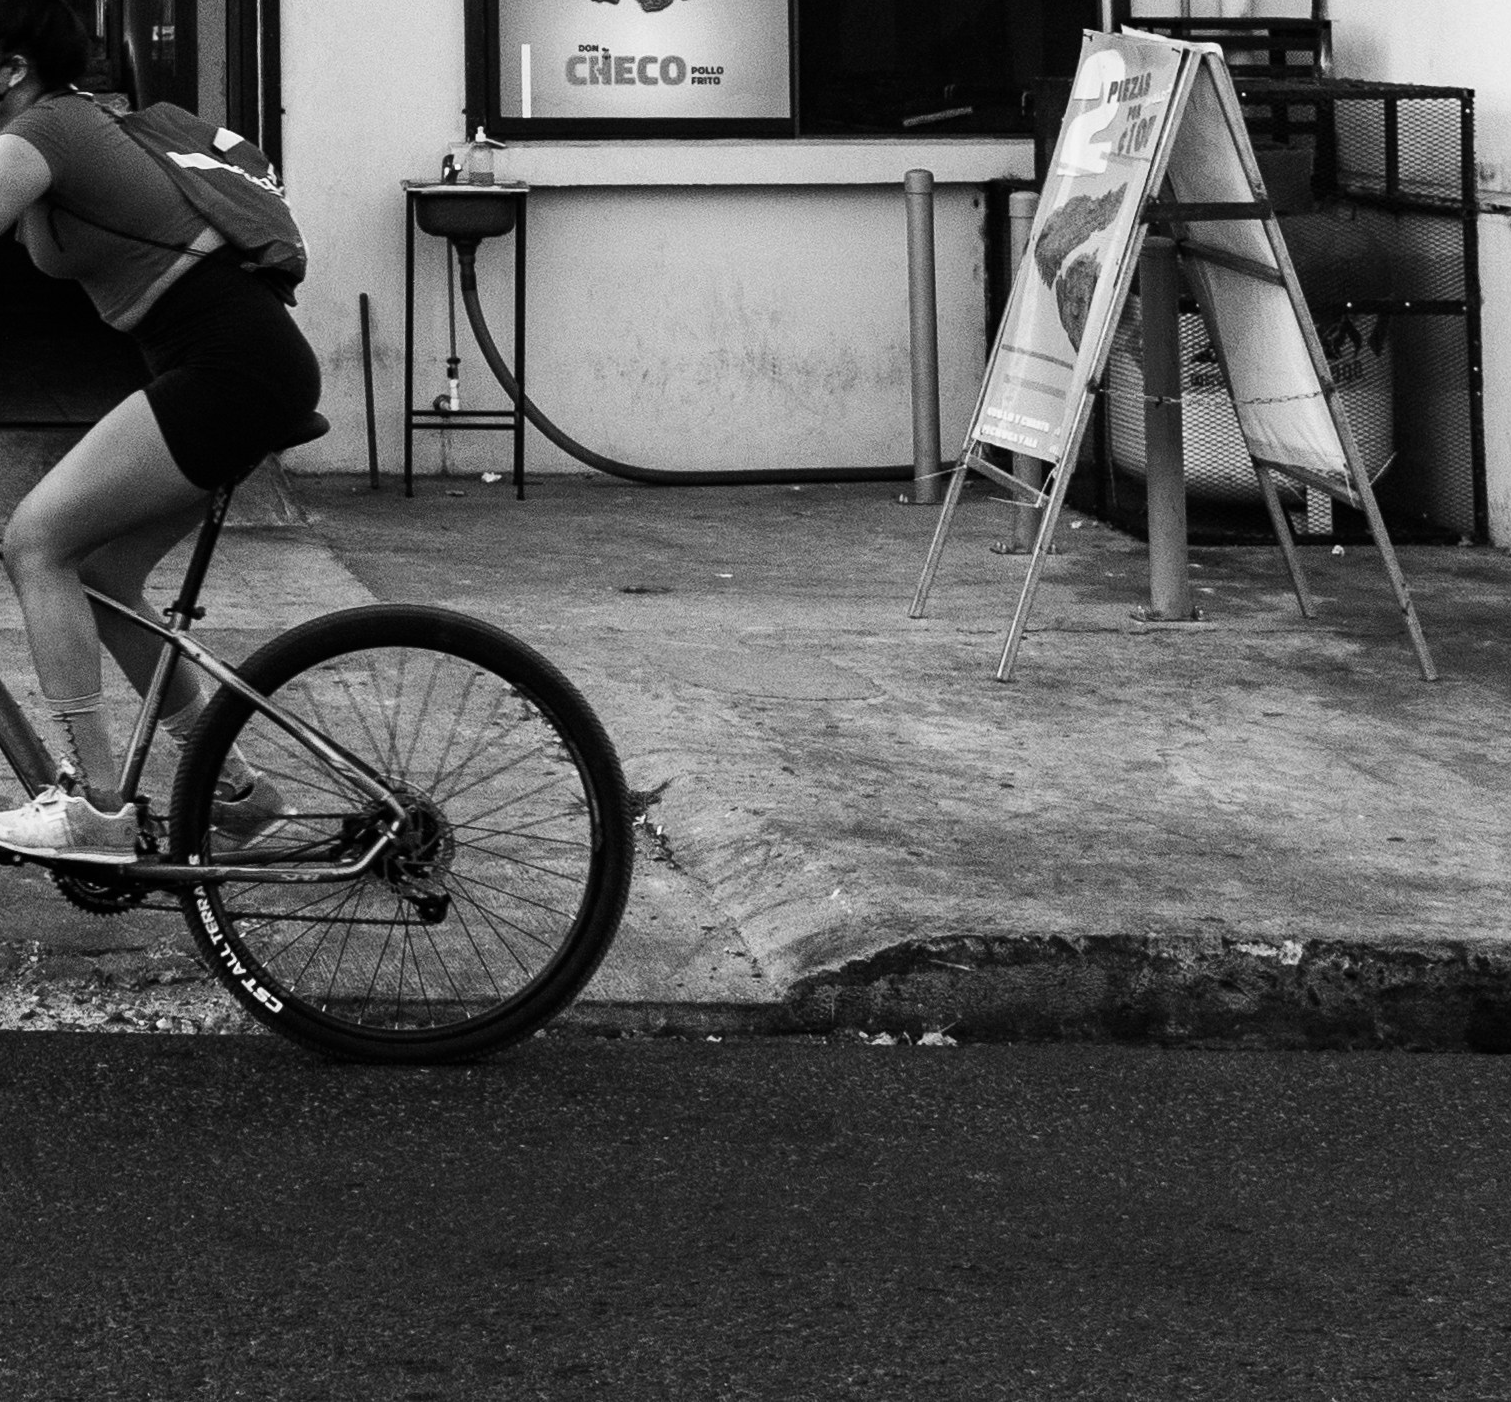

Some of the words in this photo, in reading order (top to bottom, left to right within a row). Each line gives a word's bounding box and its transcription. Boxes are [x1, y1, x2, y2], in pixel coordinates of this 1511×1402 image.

[578, 44, 599, 53] DON
[565, 54, 687, 86] CHECO
[690, 66, 724, 75] POLLO
[690, 75, 721, 86] FRITO
[1061, 48, 1126, 173] 2
[188, 854, 224, 945] TERRAS
[220, 942, 247, 975] ALL
[241, 978, 284, 1013] CST
